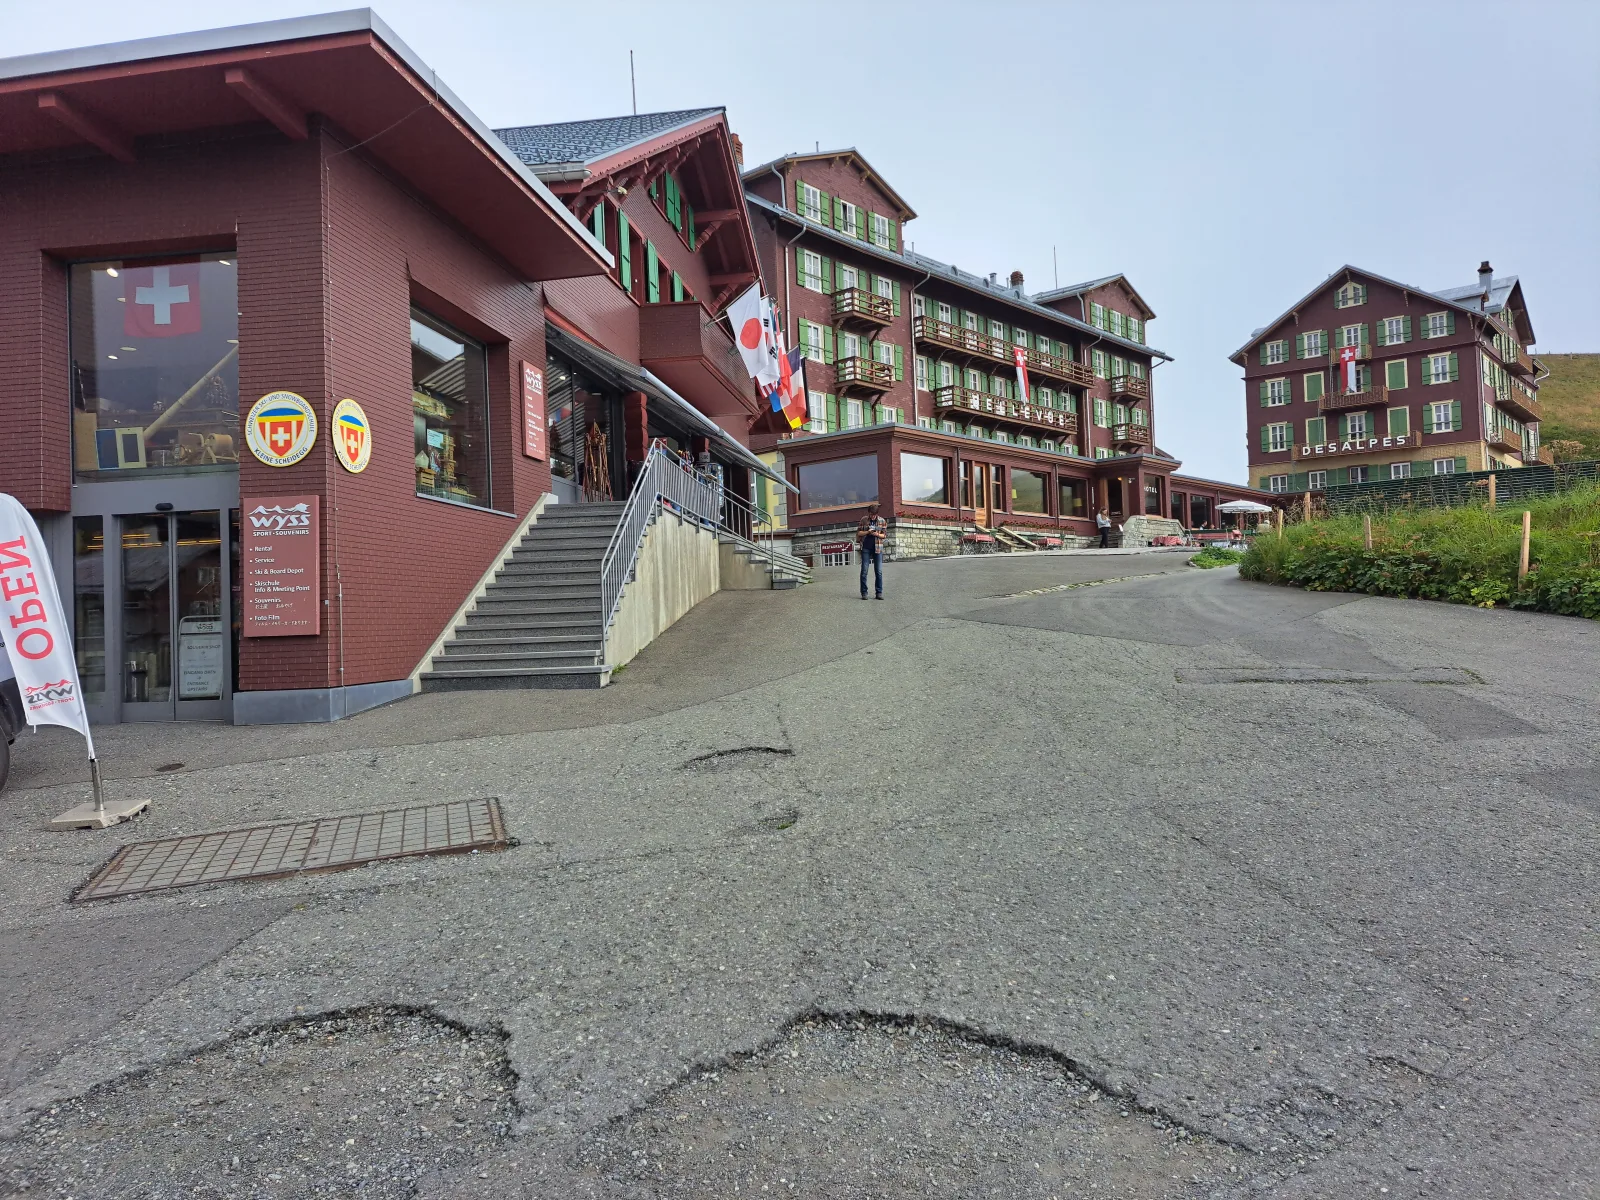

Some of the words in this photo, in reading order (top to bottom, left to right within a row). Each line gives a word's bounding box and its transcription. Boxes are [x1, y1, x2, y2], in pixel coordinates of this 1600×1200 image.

[268, 393, 280, 402] UND
[254, 448, 274, 464] KLEINE
[275, 447, 309, 464] SCHEIDEGG
